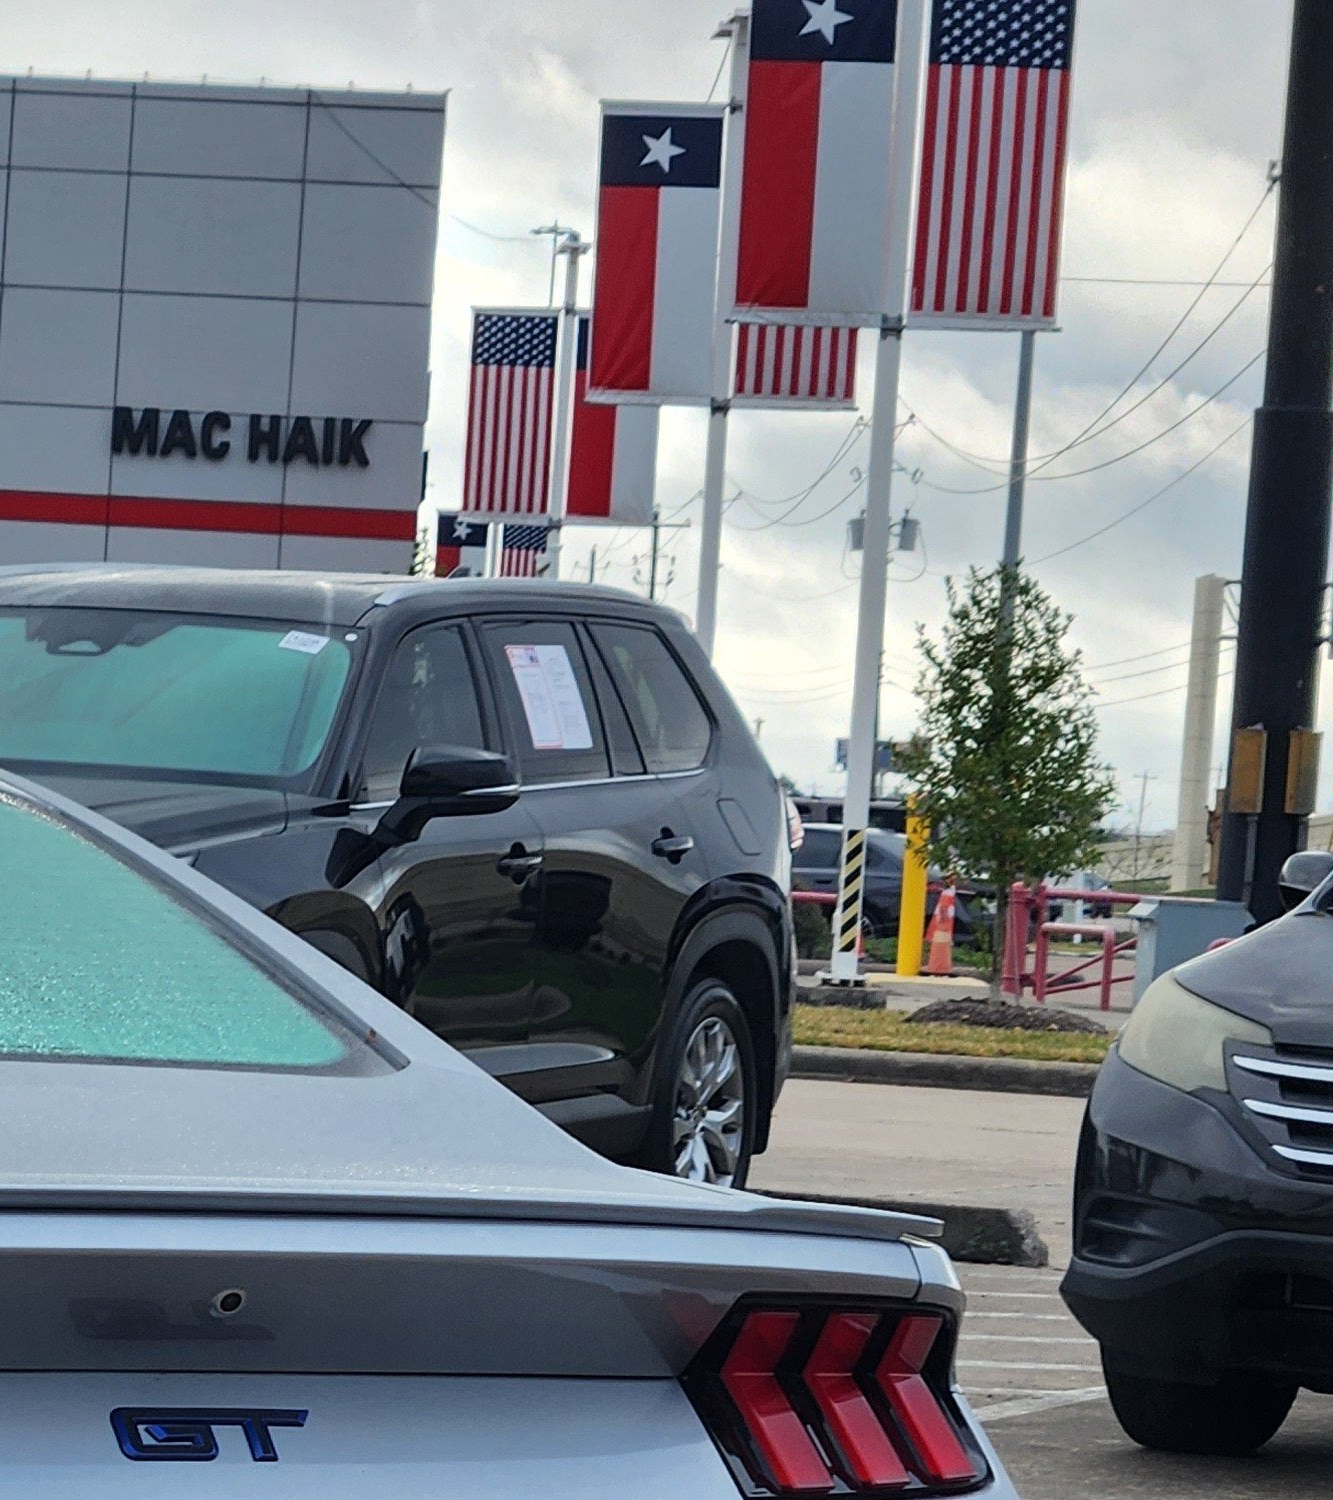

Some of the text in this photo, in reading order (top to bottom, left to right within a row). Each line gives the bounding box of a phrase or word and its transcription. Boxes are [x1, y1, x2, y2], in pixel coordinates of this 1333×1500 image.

[111, 406, 373, 467] MAC HAIK
[110, 1406, 309, 1462] GT
